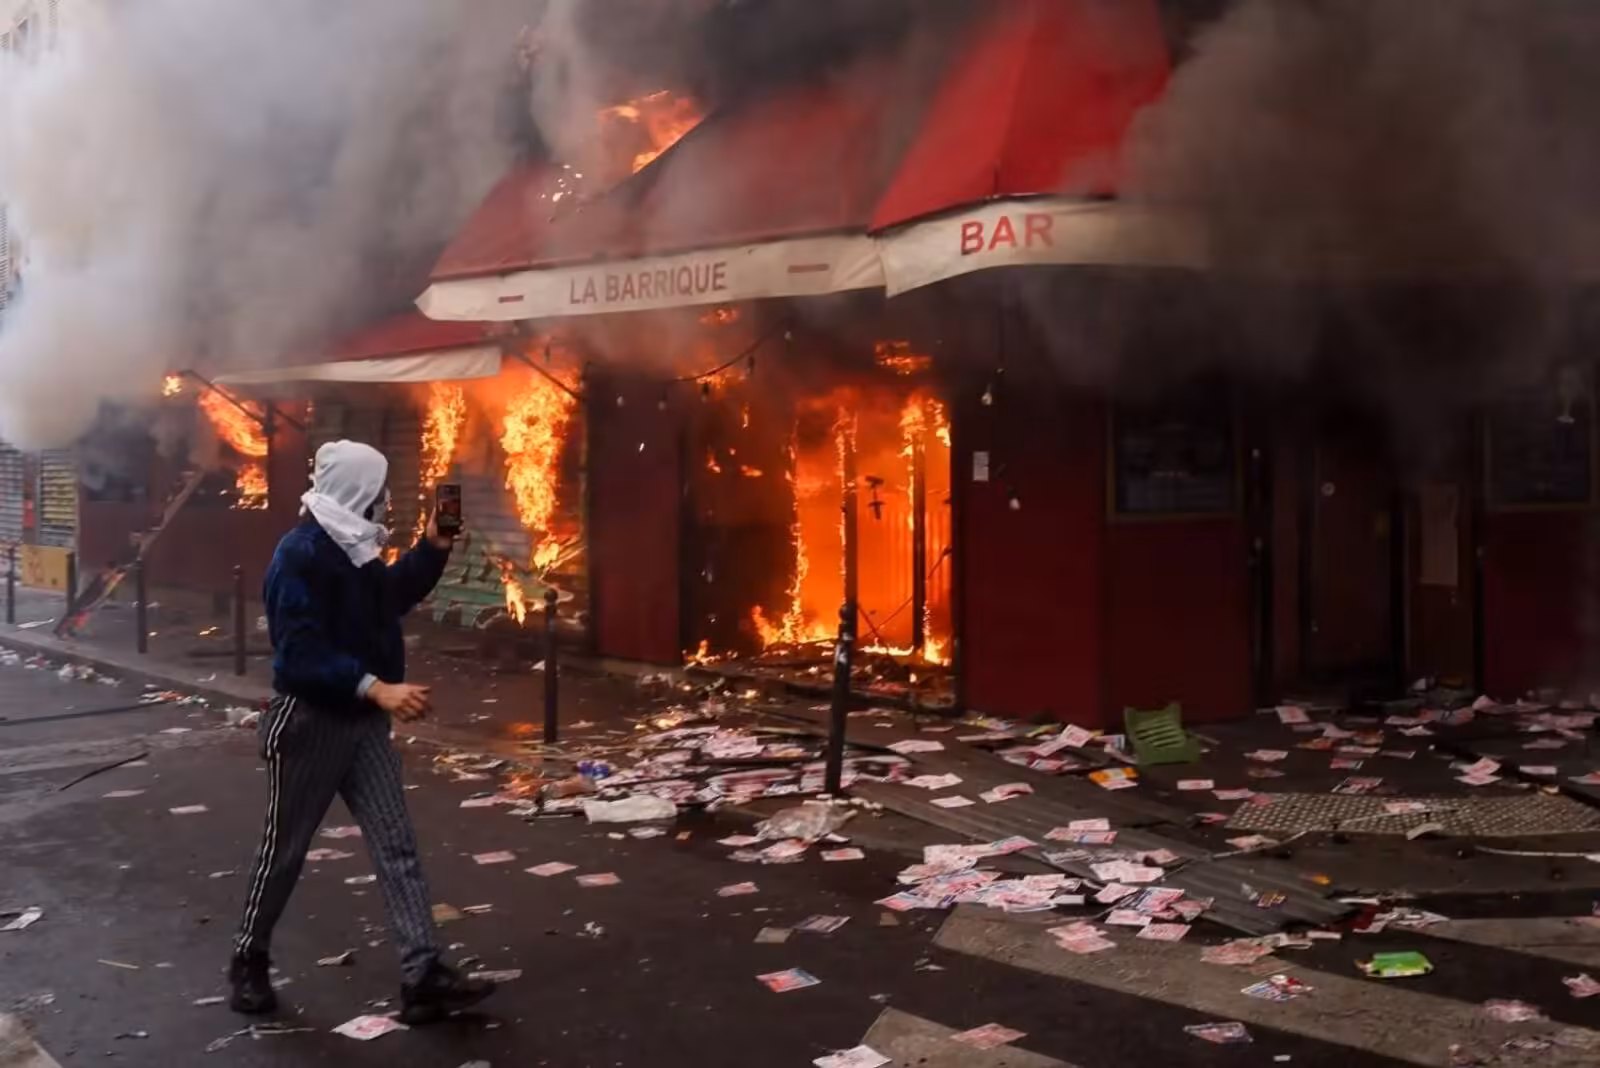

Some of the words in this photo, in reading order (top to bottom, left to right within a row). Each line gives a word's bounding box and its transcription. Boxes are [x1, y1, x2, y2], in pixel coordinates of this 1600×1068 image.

[961, 213, 1053, 255] BAR
[570, 276, 597, 304] LA
[605, 262, 727, 302] BARRIQUE
